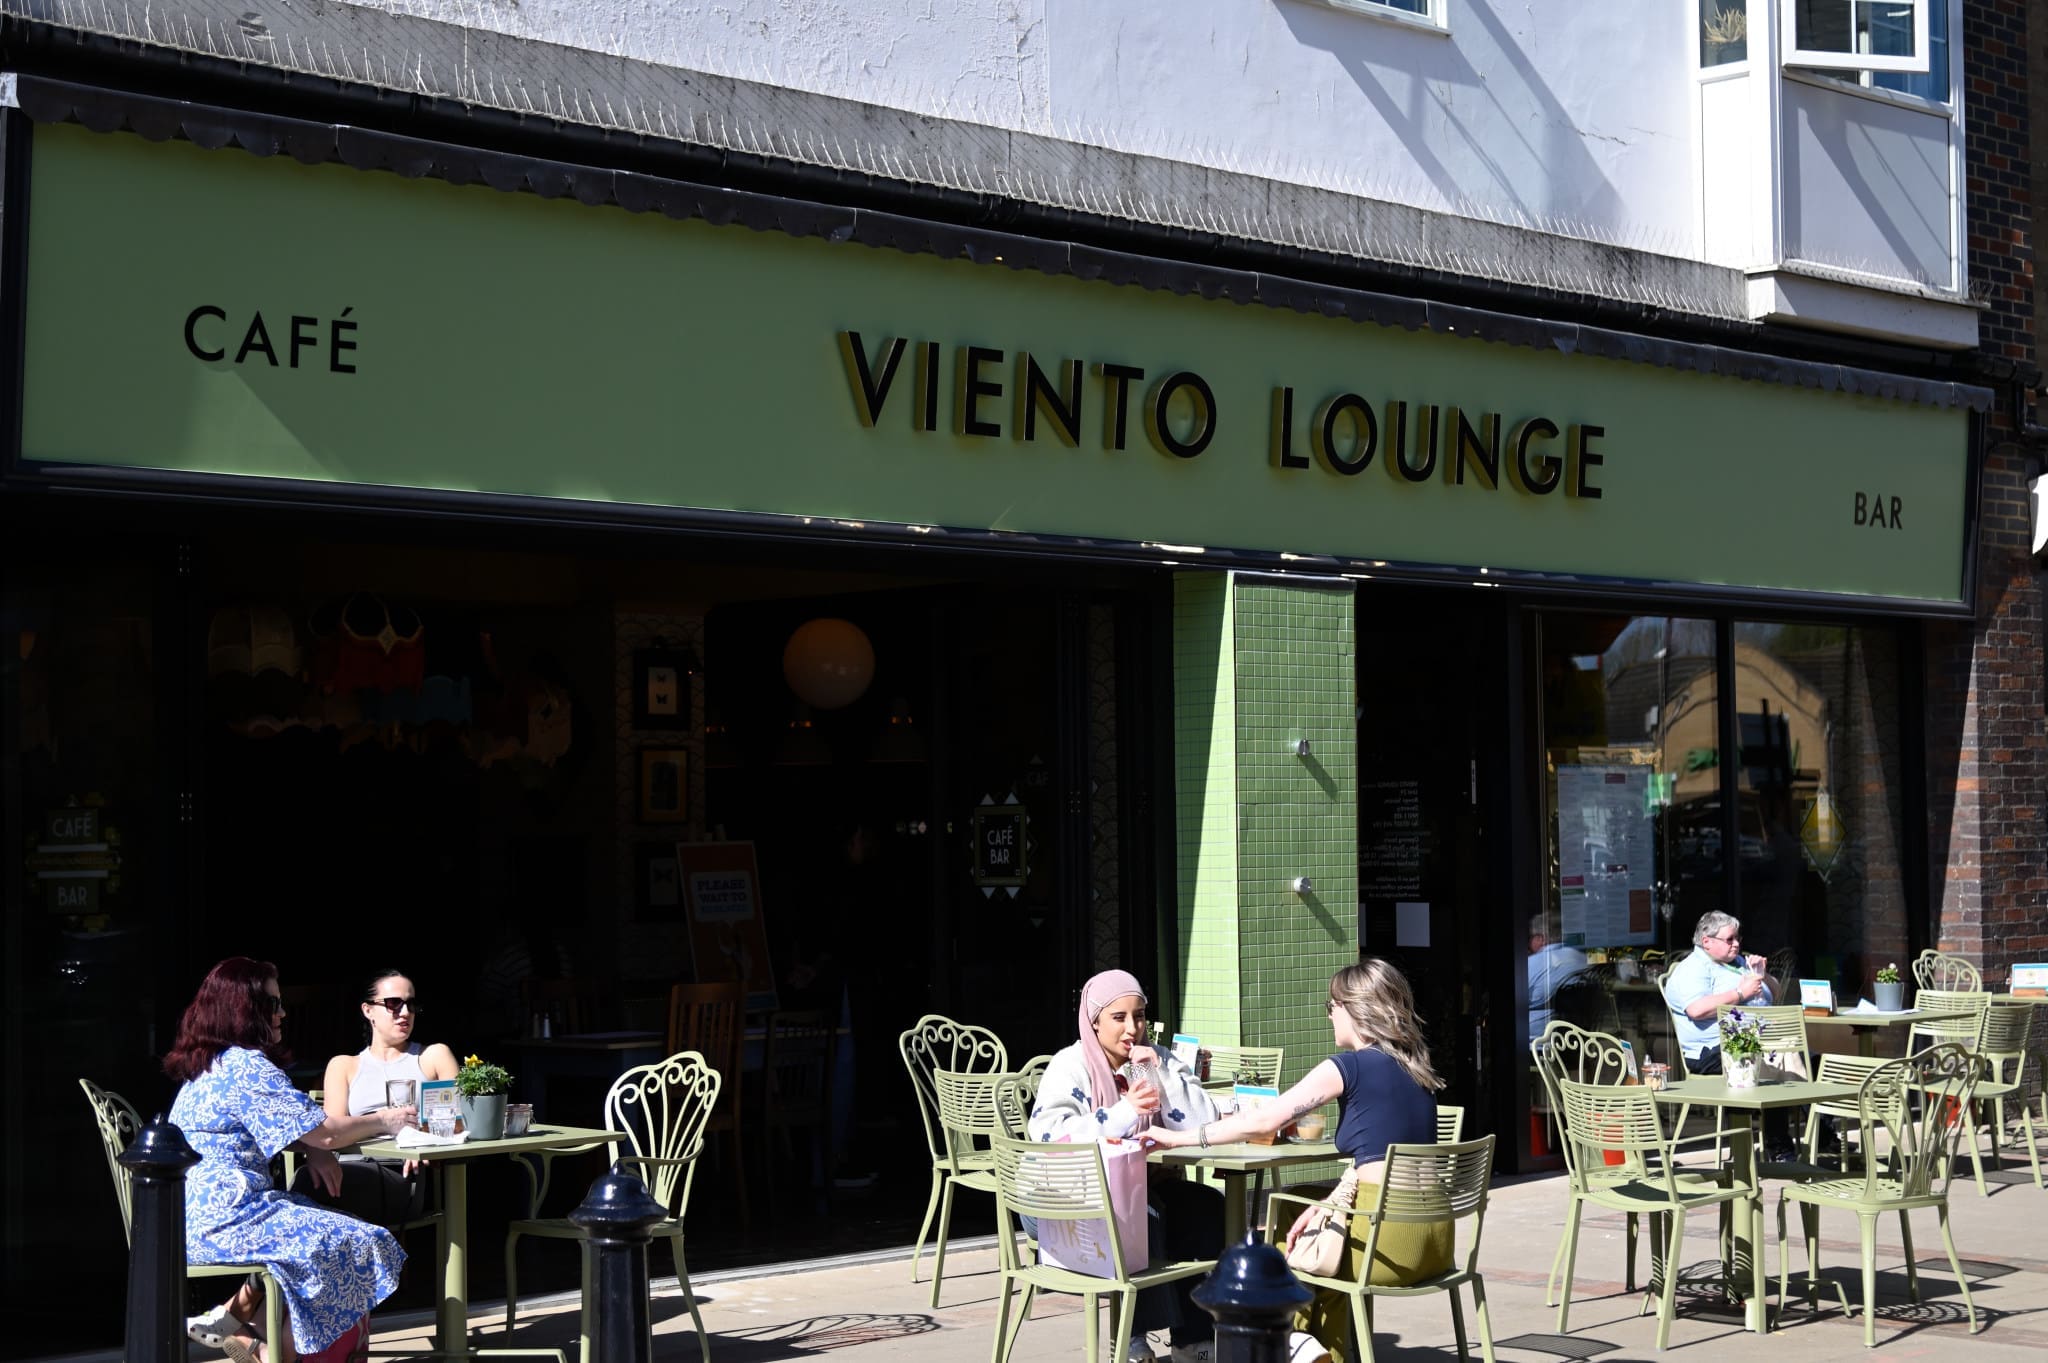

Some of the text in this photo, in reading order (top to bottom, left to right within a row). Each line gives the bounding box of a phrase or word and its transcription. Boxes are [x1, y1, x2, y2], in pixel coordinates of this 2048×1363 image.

[184, 305, 358, 374] CAFÉ
[838, 330, 1606, 499] VIENTO LOUNGE
[1854, 491, 1903, 530] BAR
[52, 812, 93, 837] CAFÉ
[987, 825, 1013, 846] CAFÉ
[990, 848, 1010, 865] BAR
[57, 885, 88, 906] BAR
[697, 879, 745, 891] PLEASE
[698, 891, 747, 903] WAIT TO
